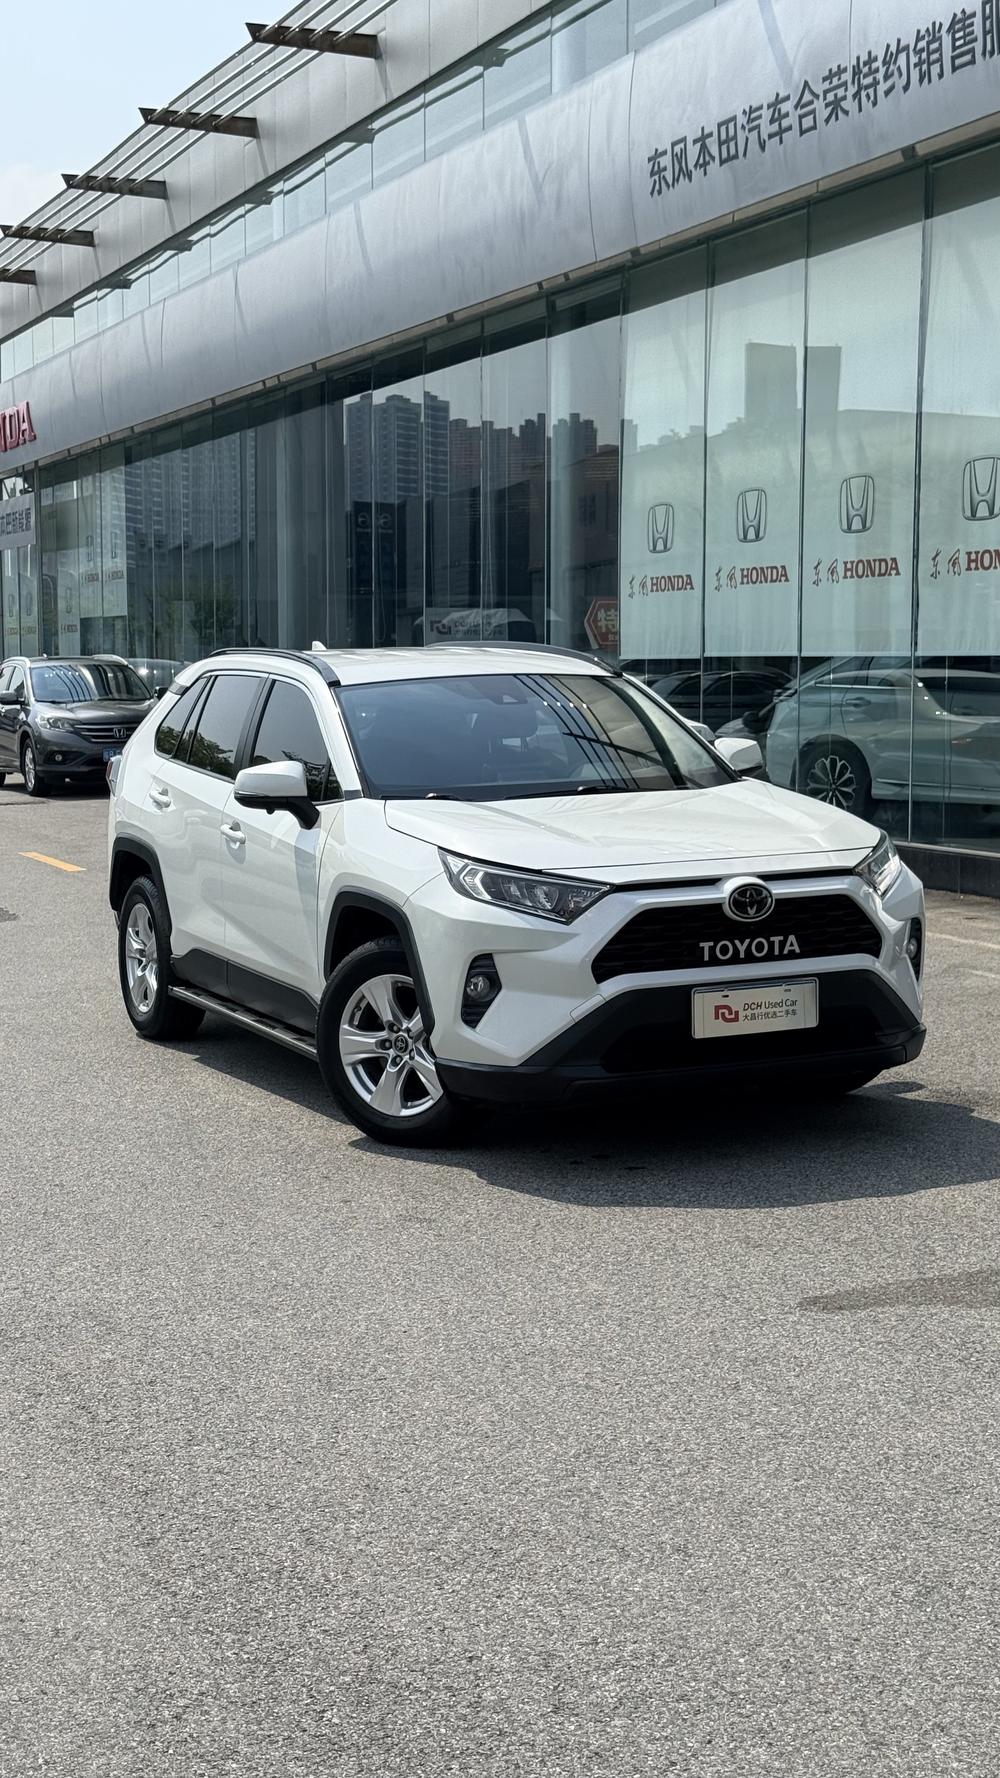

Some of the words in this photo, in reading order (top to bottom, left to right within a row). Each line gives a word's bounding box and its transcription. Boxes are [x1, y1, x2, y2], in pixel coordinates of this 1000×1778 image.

[739, 565, 789, 585] HONDA
[842, 557, 901, 580] HONDA
[650, 574, 694, 593] HONDA
[699, 934, 800, 961] TOYOTA
[743, 1002, 763, 1011] DCH
[764, 998, 784, 1010] Used
[784, 998, 798, 1007] Car
